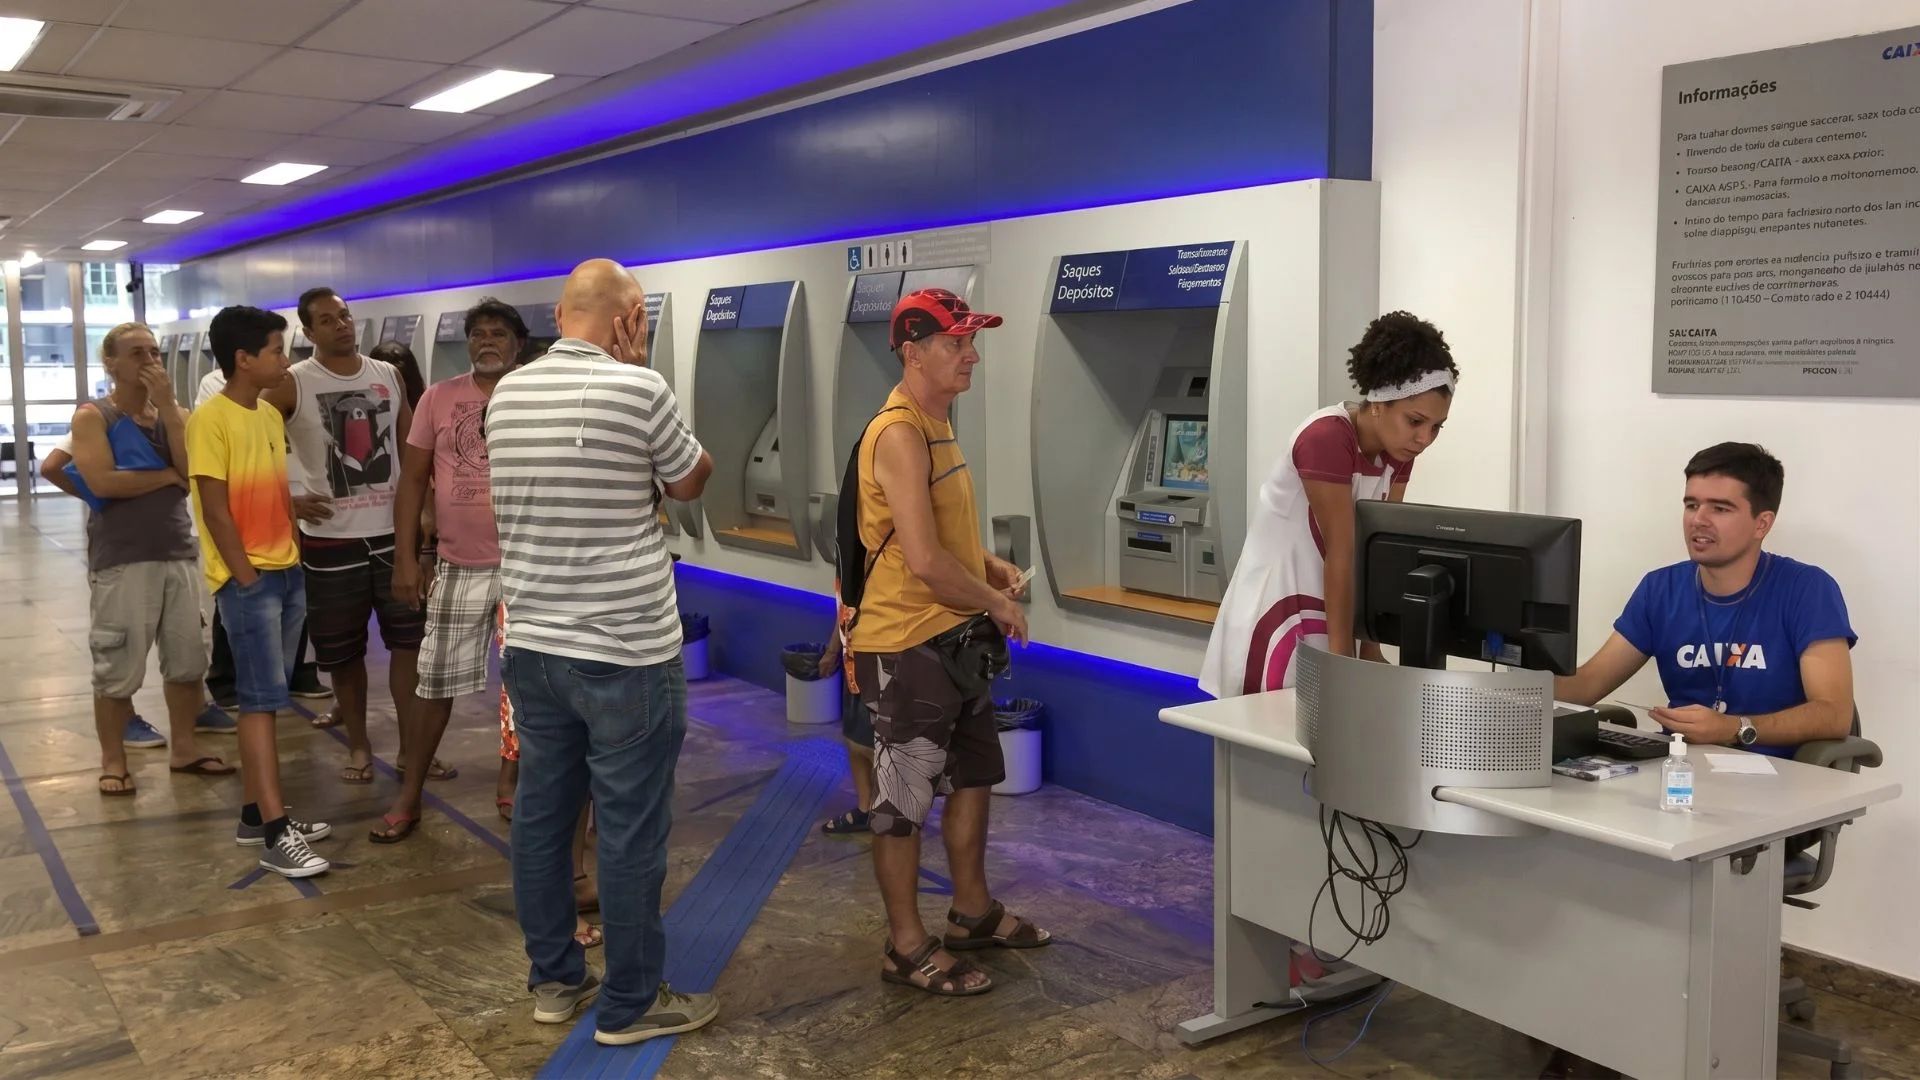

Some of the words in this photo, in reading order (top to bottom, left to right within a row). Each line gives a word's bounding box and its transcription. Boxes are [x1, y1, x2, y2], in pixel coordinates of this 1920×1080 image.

[1678, 79, 1777, 105] Informações
[1677, 132, 1697, 142] Para
[1882, 106, 1906, 118] toda
[1730, 143, 1742, 152] de
[1768, 139, 1780, 148] da
[1685, 184, 1716, 195] CAIXA
[1713, 214, 1726, 224] do
[1728, 213, 1760, 224] tempo
[1761, 210, 1784, 222] para
[1863, 201, 1883, 212] dos
[1875, 251, 1882, 259] e
[1061, 263, 1102, 282] Saques
[1849, 263, 1862, 274] de
[1057, 284, 1114, 303] Depósitos
[1753, 281, 1765, 291] de
[1676, 642, 1767, 670] CAIXA
